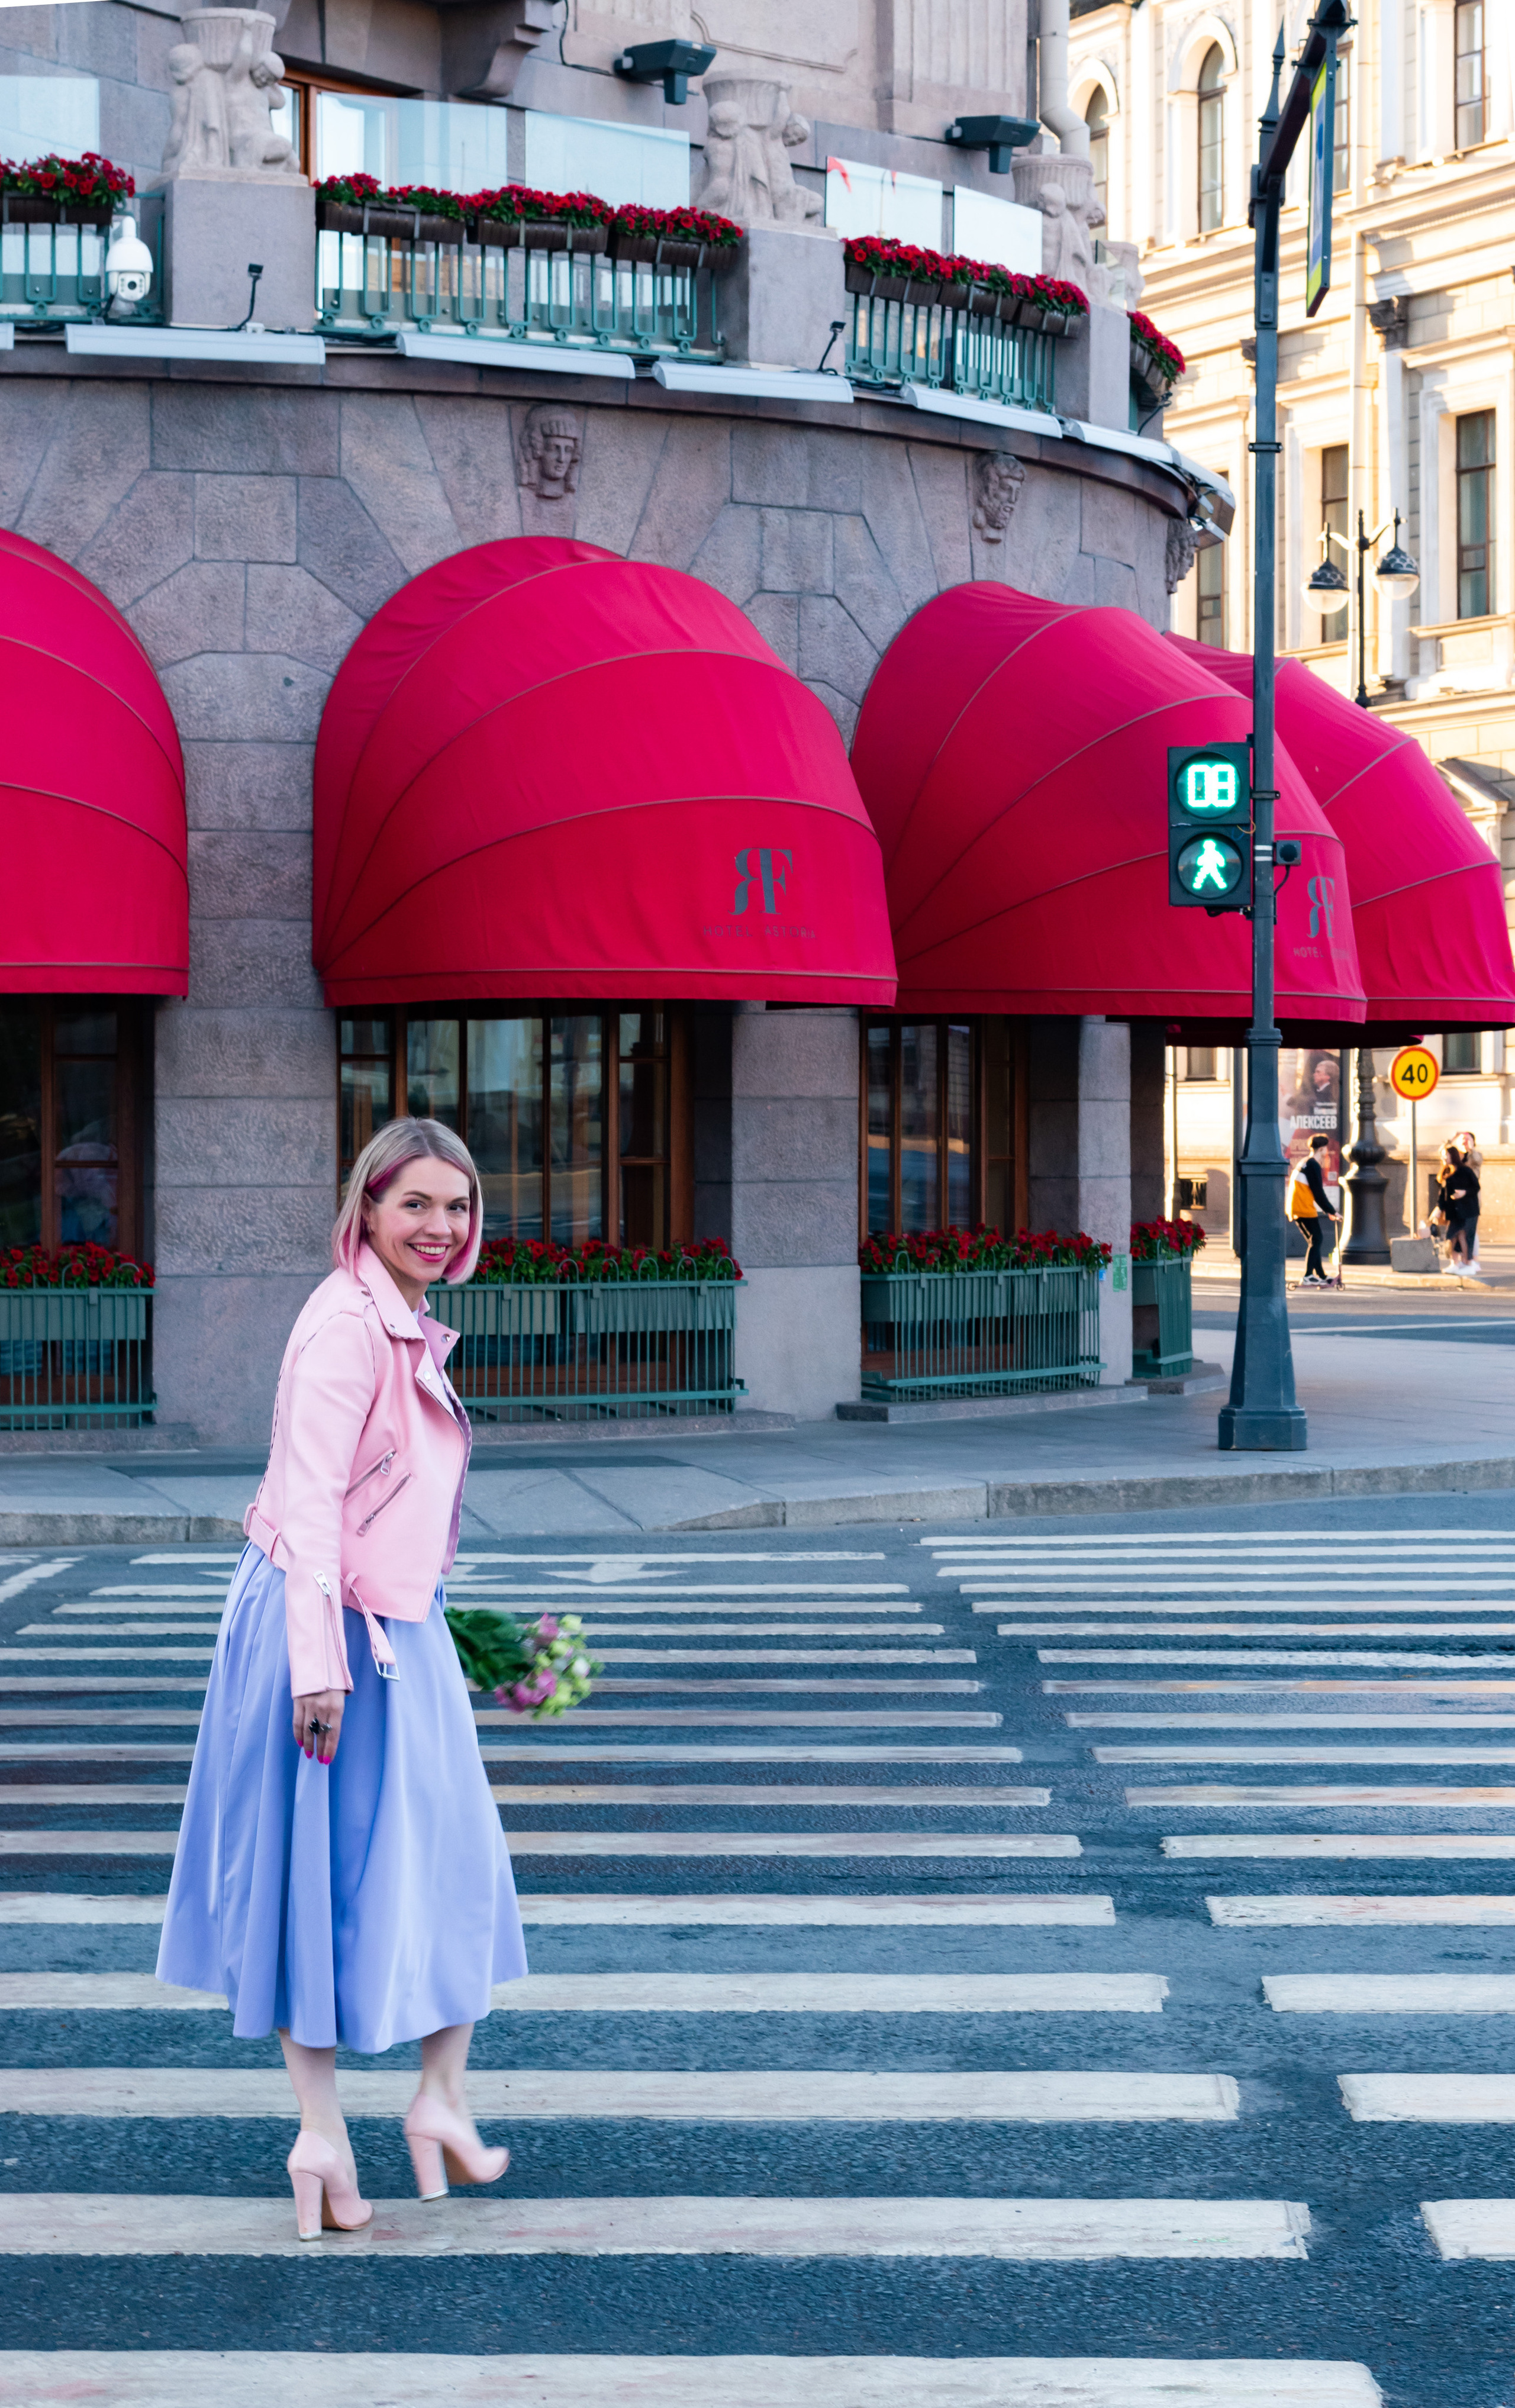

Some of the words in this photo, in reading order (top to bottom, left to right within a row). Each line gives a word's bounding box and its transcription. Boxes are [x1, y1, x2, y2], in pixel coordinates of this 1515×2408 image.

[1187, 763, 1236, 808] 08
[703, 925, 753, 937] HOTEL
[765, 924, 816, 939] ASTORIA
[1293, 946, 1324, 958] HOTEL
[1401, 1063, 1428, 1084] 40
[1290, 1115, 1337, 1129] АЛЕКСЕЕВ
